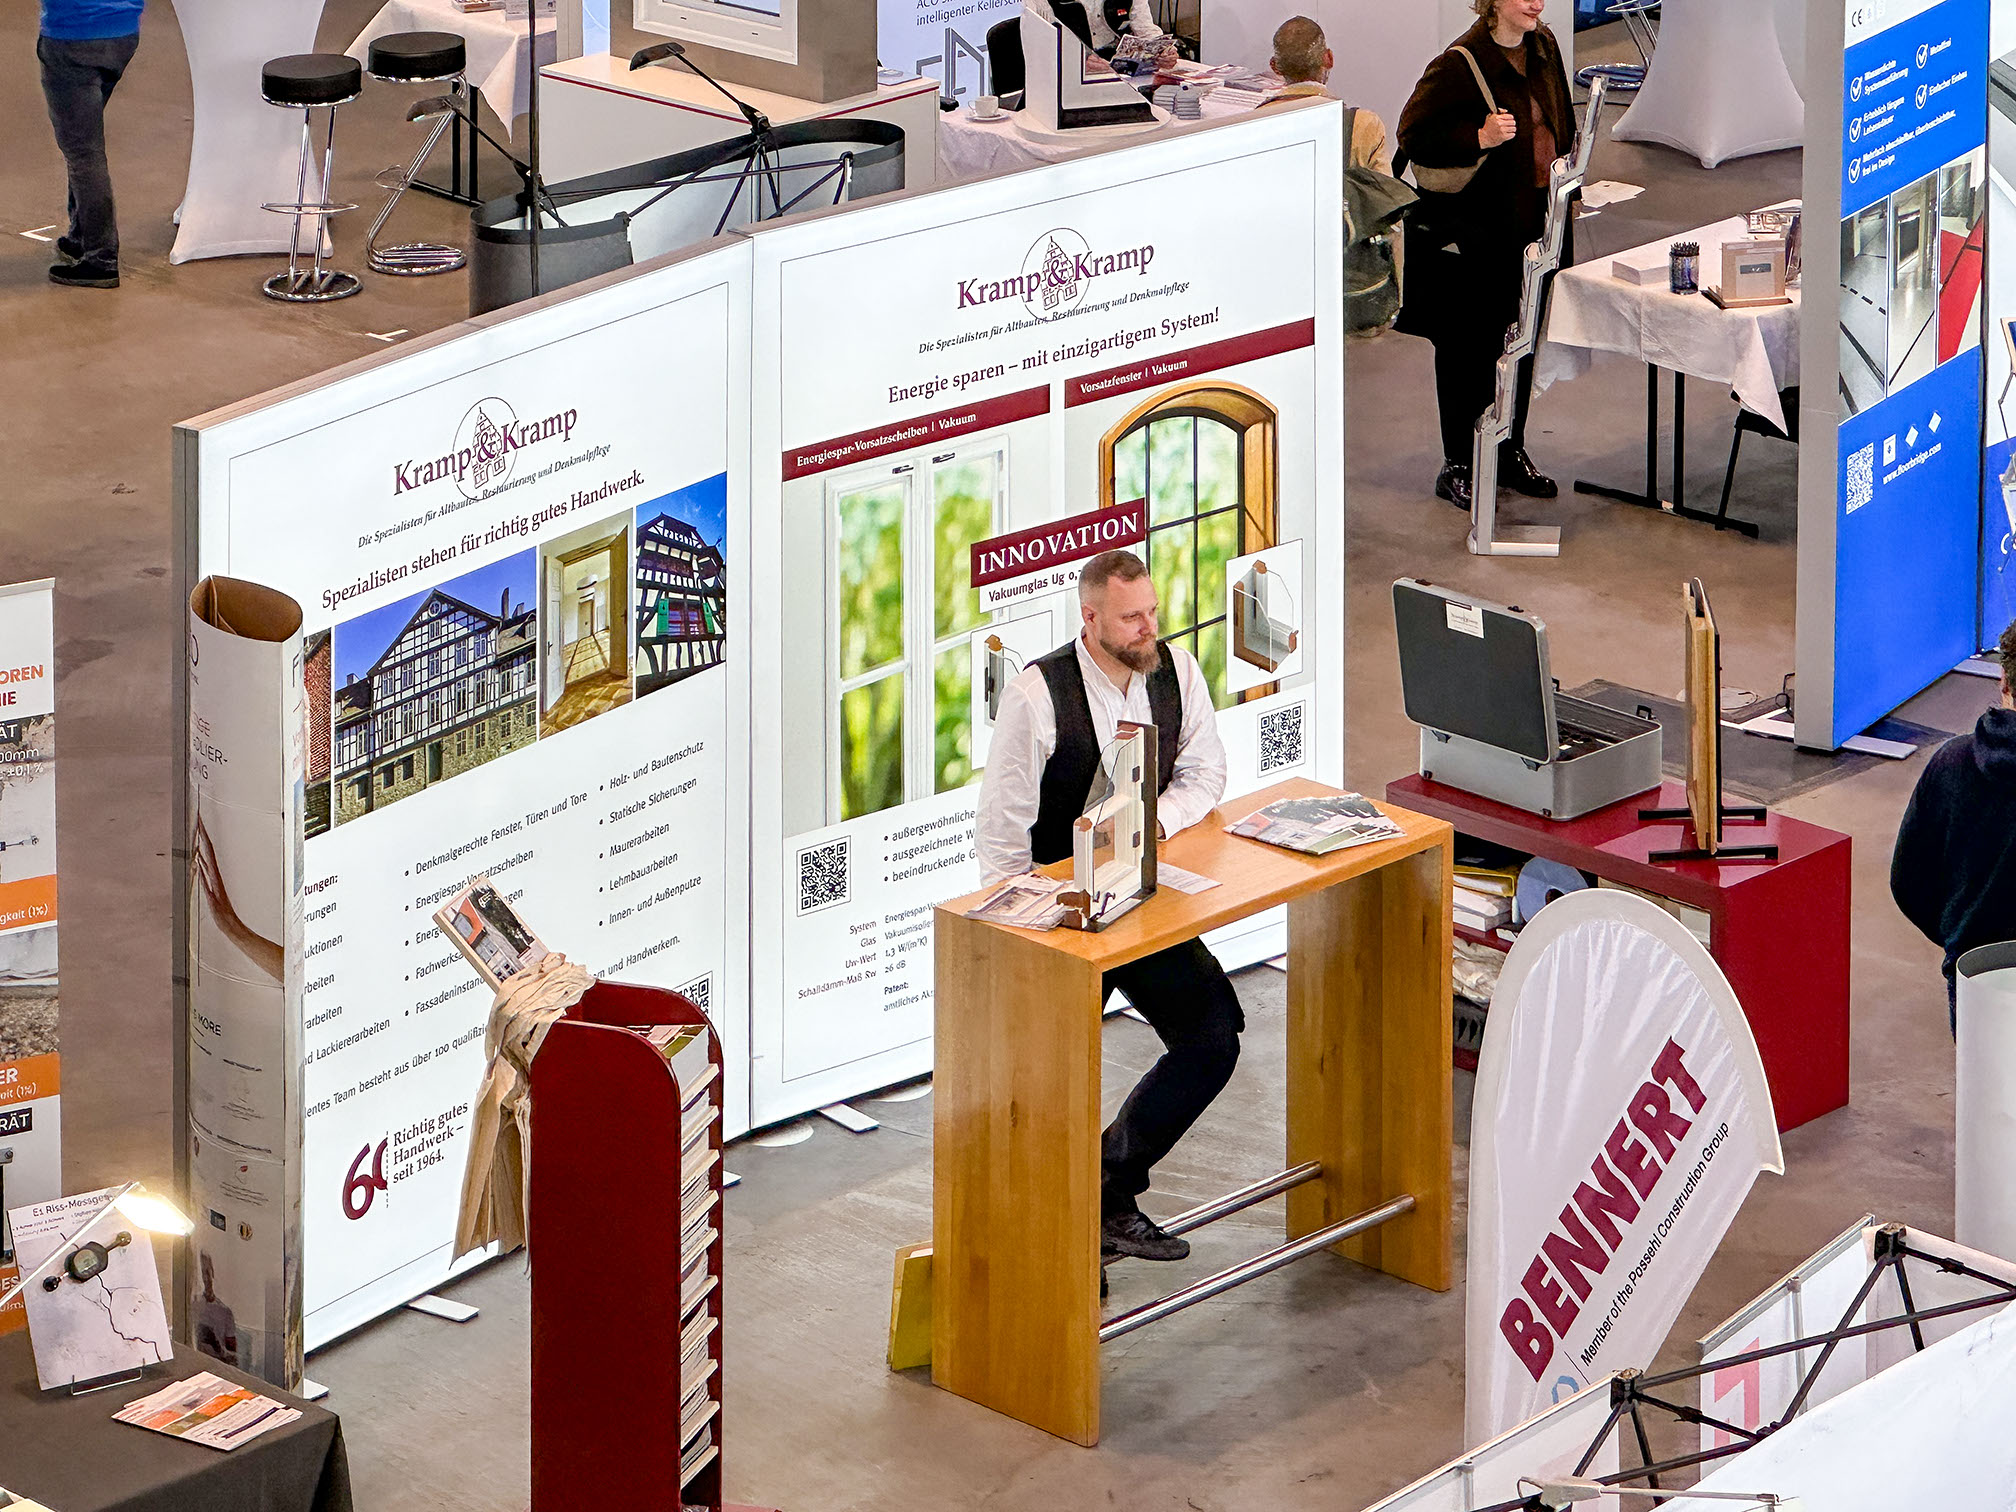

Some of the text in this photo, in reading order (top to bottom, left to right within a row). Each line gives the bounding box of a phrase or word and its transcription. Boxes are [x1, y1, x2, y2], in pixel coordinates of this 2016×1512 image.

[916, 4, 976, 26] intelligenter
[957, 270, 1042, 309] Kramp
[1072, 244, 1155, 282] Kramp
[918, 341, 934, 354] Die
[936, 329, 989, 352] Spezialisten
[989, 325, 1003, 340] für
[1052, 299, 1111, 322] Restaurierung
[1111, 294, 1129, 308] und
[1129, 279, 1190, 303] Denkmalpflege
[889, 374, 949, 404] Energie
[952, 363, 1005, 392] sparen
[1022, 350, 1049, 370] mit
[1052, 325, 1157, 363] einzigartigem
[1161, 306, 1220, 337] System!
[1080, 369, 1143, 395] Vorsatzfenster
[1151, 358, 1188, 377] Vakuum
[394, 448, 472, 496] Kramp
[501, 408, 578, 455] Kramp
[797, 424, 928, 468] Energiespar-Vorsatzscheiben
[938, 411, 976, 430] Vakuum
[358, 536, 373, 548] Die
[374, 516, 424, 542] Spezialisten
[424, 510, 437, 527] für
[482, 473, 537, 500] Restaurierung
[537, 466, 553, 481] und
[554, 443, 612, 472] Denkmalpflege
[322, 468, 645, 611] Spezialisten stehen für richtig gutes Handwerk.
[978, 511, 1138, 576] INNOVATION
[988, 577, 1049, 603] Vakuumglas
[1052, 571, 1065, 589] Ug
[0, 664, 44, 685] OREN
[193, 736, 228, 764] OLIER-
[609, 741, 705, 790] Holz- und Bautenschutz
[33, 763, 44, 774] %
[609, 777, 698, 825] Statische Sicherungen
[415, 791, 588, 876] Denkmalgerechte Fenster, Türen und Tore
[609, 822, 670, 858] Maurerarbeiten
[892, 810, 976, 842] außergewöhnliche
[892, 831, 963, 863] ausgezeichnete
[304, 874, 338, 897] tungen:
[609, 852, 679, 891] Lehmbauarbeiten
[892, 853, 966, 883] beeindruckende
[304, 902, 337, 923] rungen
[609, 875, 703, 926] Innen- und Außenputze
[849, 919, 878, 936] System
[860, 936, 878, 949] Glas
[304, 934, 343, 960] uktionen
[608, 959, 625, 977] und
[626, 936, 681, 967] Handwerkern.
[845, 953, 878, 969] Uw-Wert
[415, 951, 464, 980] Fachwerksa
[304, 972, 335, 996] rbeiten
[798, 973, 863, 1000] Schalldämm-Maß
[884, 982, 910, 996] Patent:
[884, 994, 920, 1013] amtliches
[316, 1017, 391, 1061] Lackiererarbeiten
[0, 1066, 19, 1085] ER
[333, 1086, 357, 1105] Team
[359, 1069, 393, 1094] besteht
[394, 1063, 410, 1077] aus
[412, 1050, 432, 1069] über
[435, 1044, 450, 1058] 100
[452, 1022, 487, 1051] qualifizi
[0, 1111, 30, 1132] RÄT
[393, 1102, 468, 1148] Richtig gutes
[393, 1127, 455, 1166] Handwerk
[393, 1150, 446, 1184] seit 1964.
[1500, 1036, 1708, 1383] BENNERT
[1581, 1121, 1730, 1368] Member of the Possehl Construction Group
